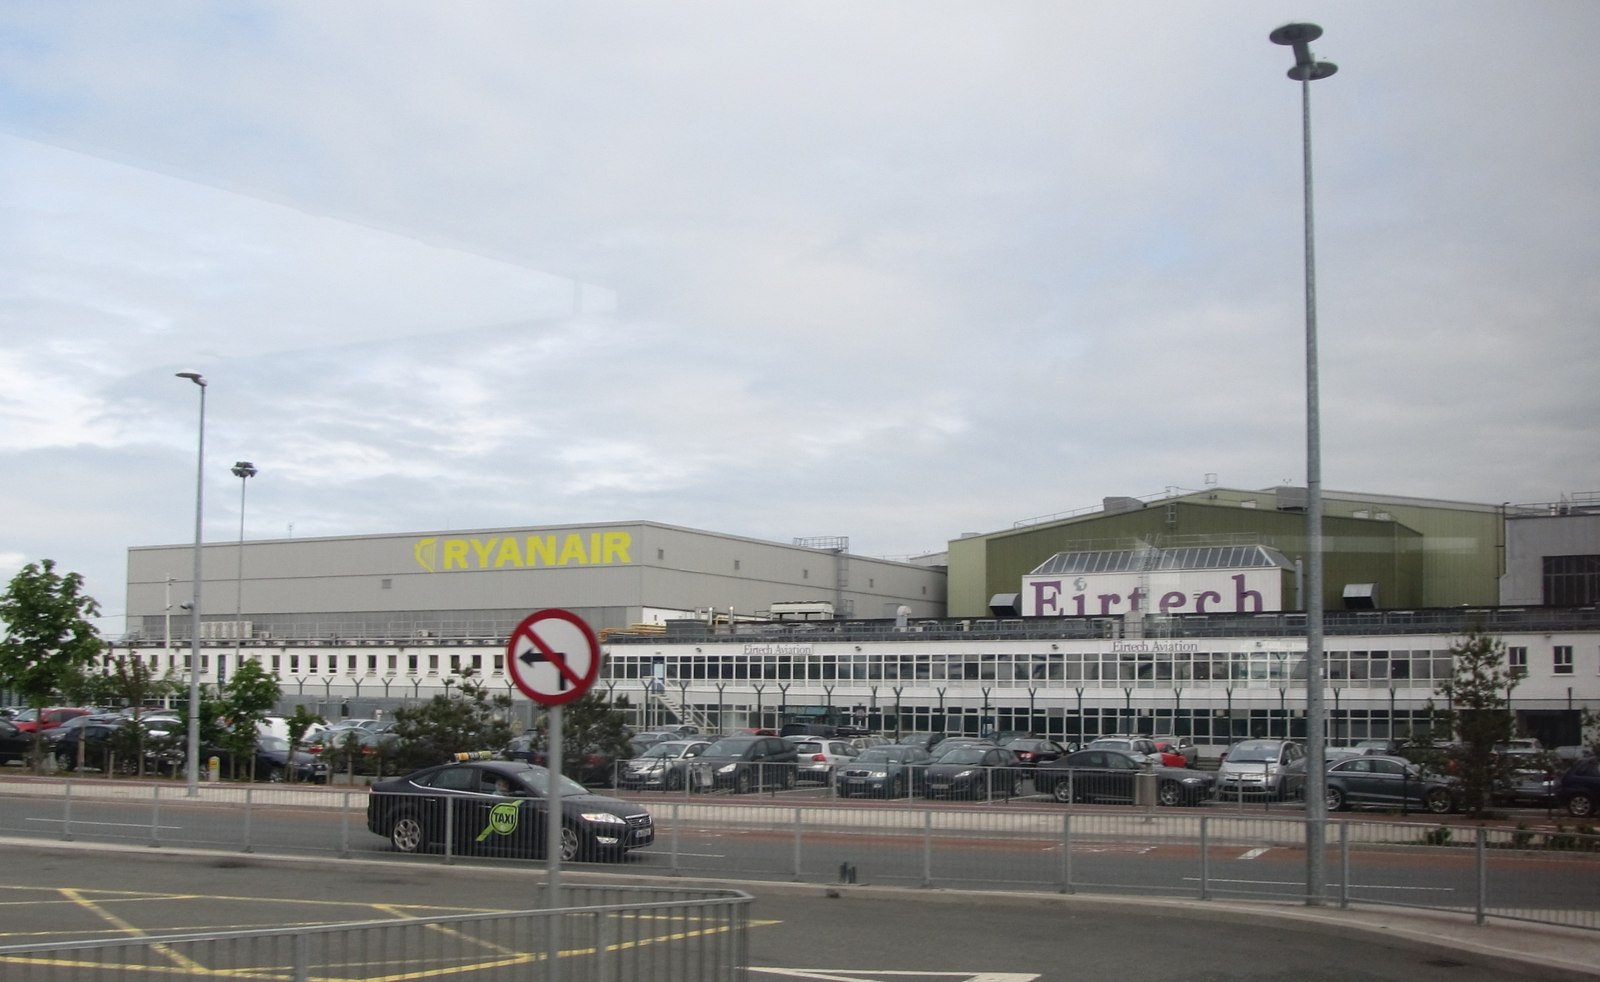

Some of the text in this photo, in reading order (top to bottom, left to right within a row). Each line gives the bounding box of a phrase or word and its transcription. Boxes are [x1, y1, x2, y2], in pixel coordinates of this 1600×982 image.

[442, 531, 632, 570] RYANAIR
[1030, 574, 1263, 616] Eirtech
[744, 644, 811, 655] Eirtech Aviation
[1113, 641, 1198, 653] Eirtech Aviation
[494, 812, 514, 825] TAXI
